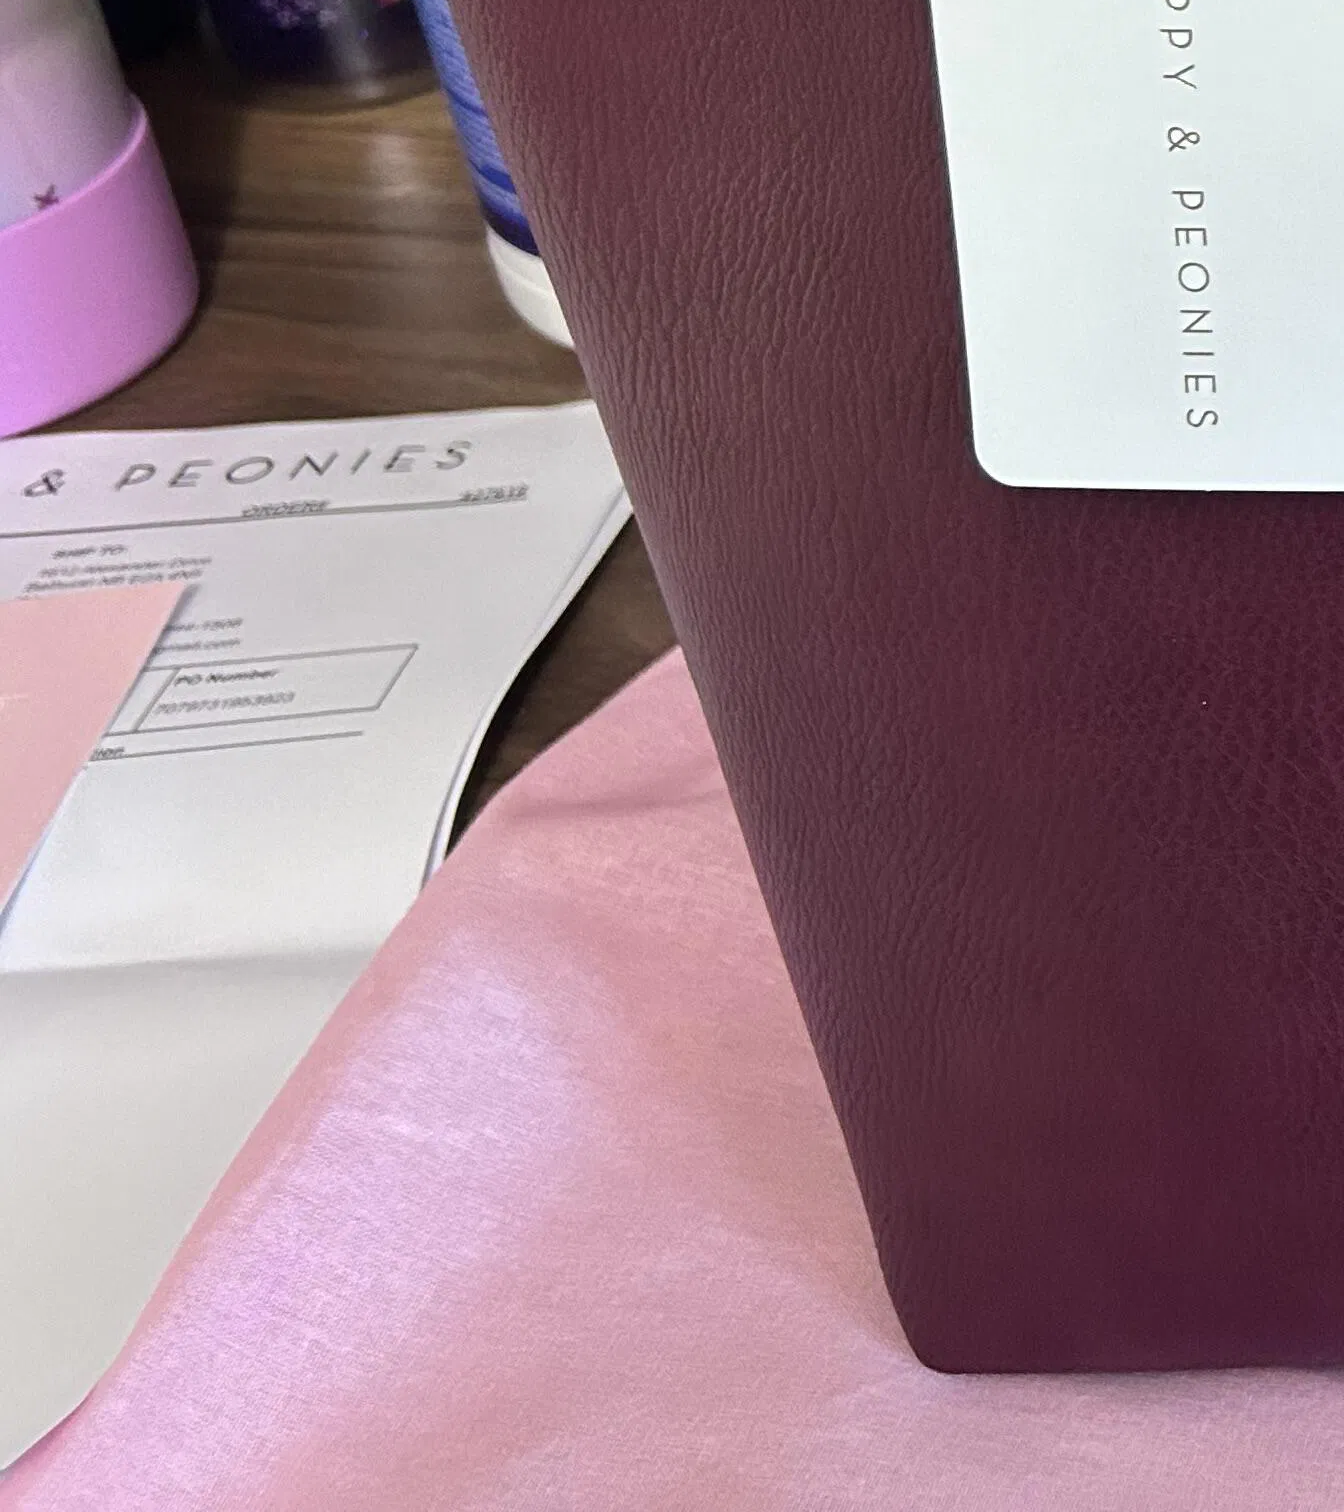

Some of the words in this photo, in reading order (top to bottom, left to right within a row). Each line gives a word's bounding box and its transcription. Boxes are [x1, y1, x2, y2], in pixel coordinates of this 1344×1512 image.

[1166, 125, 1202, 153] &
[1170, 188, 1221, 430] PEONIES
[21, 467, 66, 498] &
[114, 439, 472, 492] PEONIES
